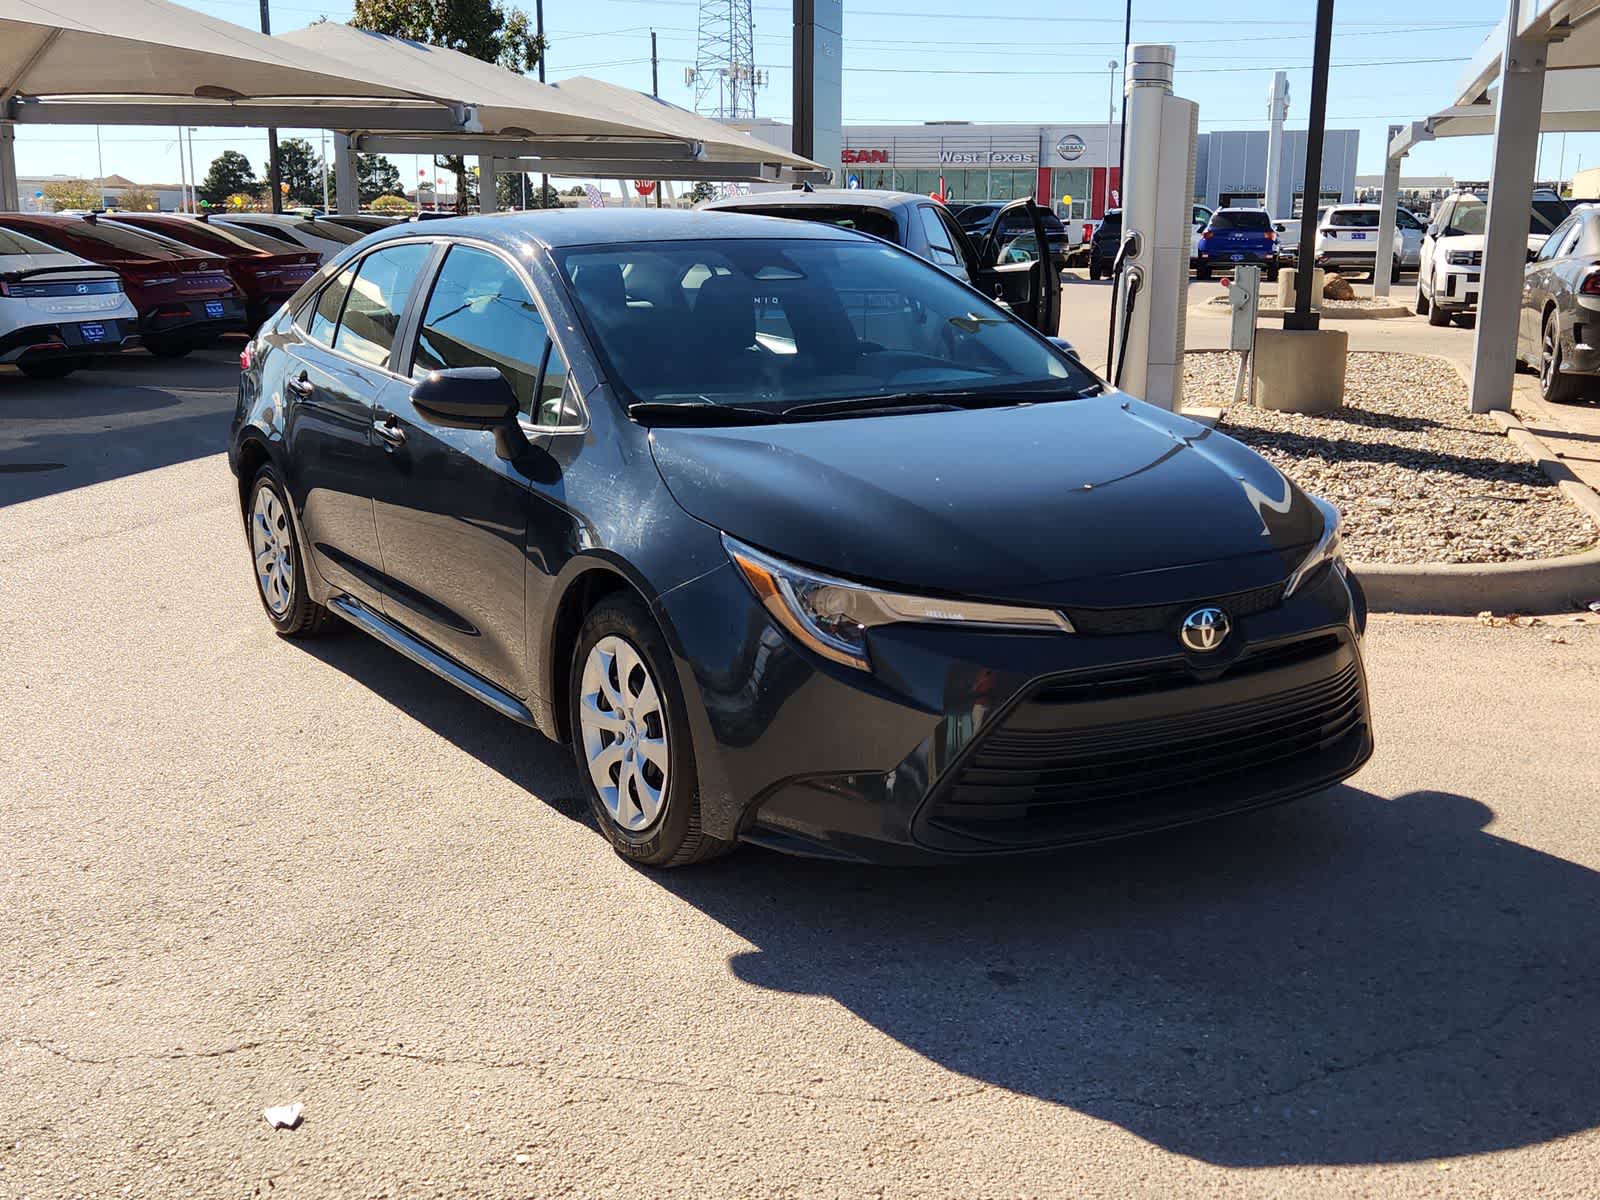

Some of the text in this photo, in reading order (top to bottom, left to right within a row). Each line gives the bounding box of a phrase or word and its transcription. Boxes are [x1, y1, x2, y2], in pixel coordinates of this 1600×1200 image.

[937, 151, 1033, 163] West Texas
[635, 179, 655, 188] STOP
